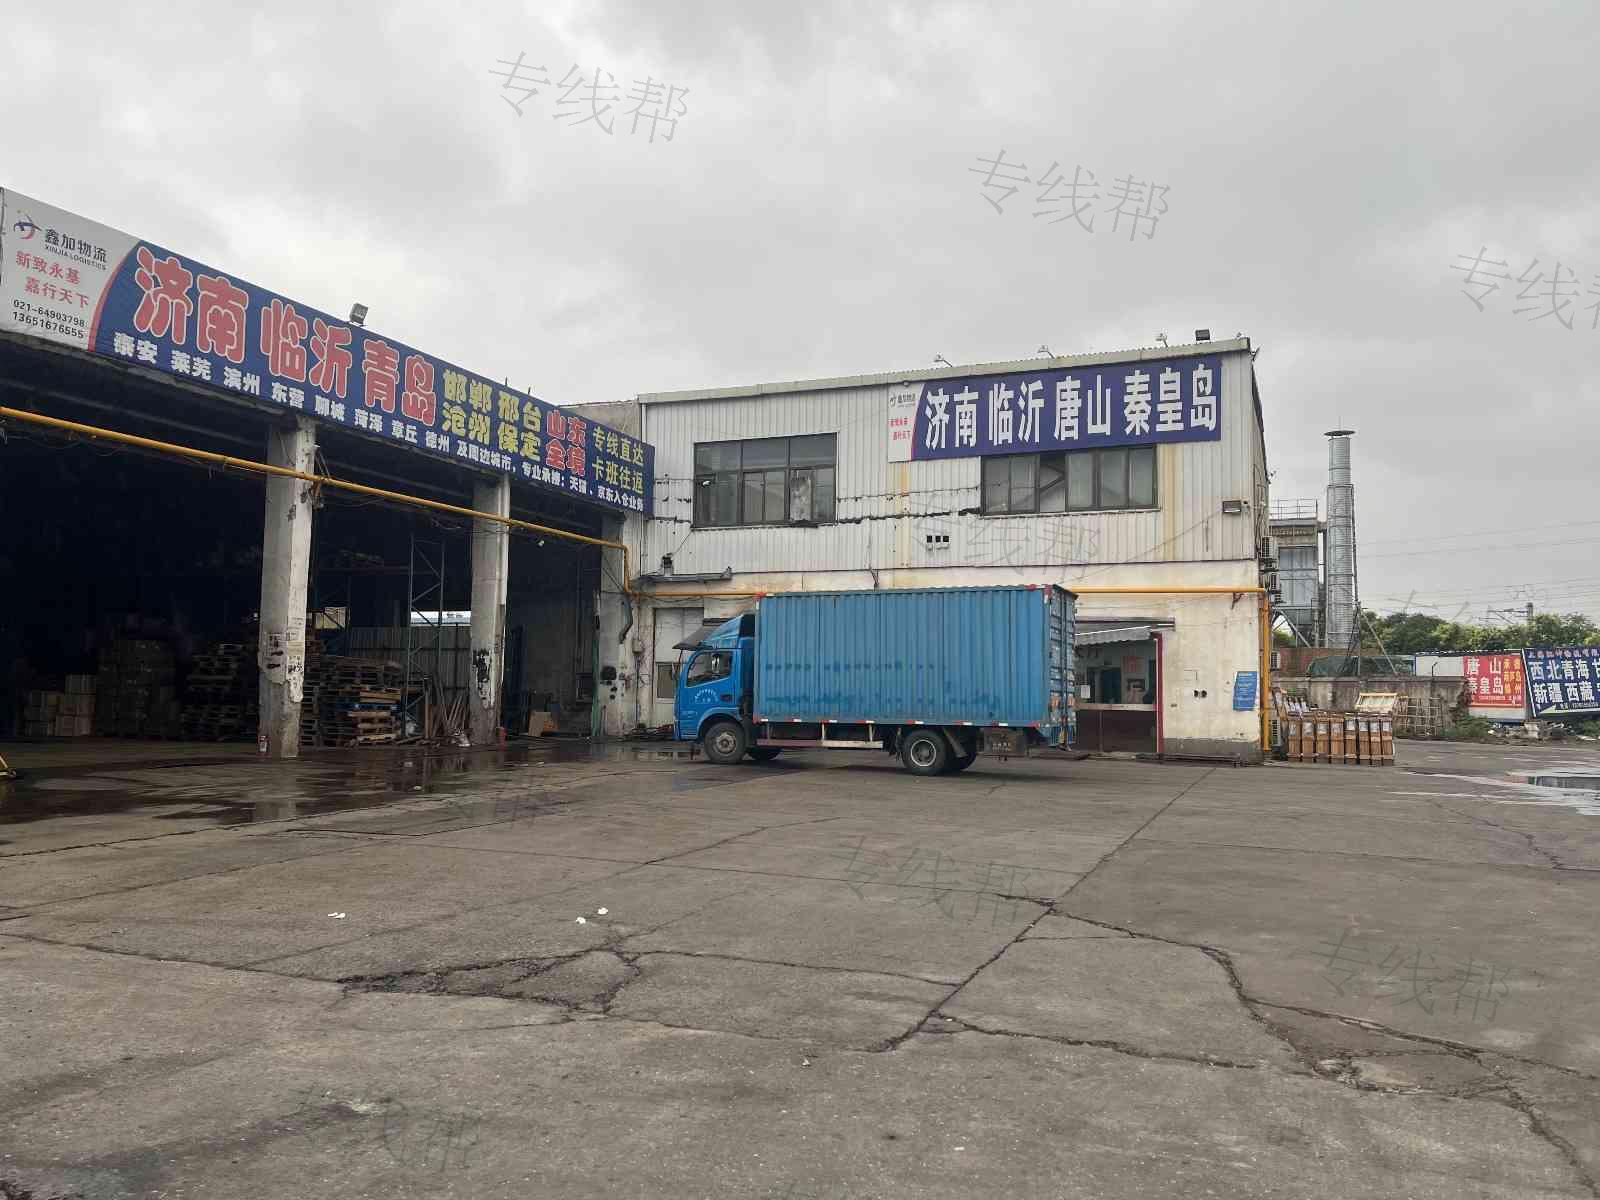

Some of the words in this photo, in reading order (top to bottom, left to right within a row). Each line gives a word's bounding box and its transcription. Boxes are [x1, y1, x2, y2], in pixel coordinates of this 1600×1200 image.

[44, 228, 107, 263] 鑫加物流
[44, 244, 69, 257] XINJIA
[71, 253, 107, 271] LOGISTICS
[15, 250, 81, 285] 新致永基
[25, 276, 90, 309] 嘉行天下
[12, 311, 85, 339] 13651676555
[134, 246, 249, 364] 济南
[260, 298, 352, 398] 临沂
[362, 338, 437, 427] 青岛
[171, 350, 212, 381] 莱芜
[223, 366, 261, 396] 滨州
[271, 382, 305, 409] 东营
[354, 408, 383, 433] 菏泽
[391, 420, 418, 444] 章丘
[425, 430, 450, 453] 德州
[443, 368, 493, 413] 邯郸
[498, 389, 542, 433] 邢台
[925, 385, 979, 450] 济南
[988, 379, 1046, 446] 临沂
[1053, 374, 1112, 442] 唐山
[1123, 363, 1217, 436] 秦皇岛
[441, 401, 491, 446] 沧州
[498, 422, 542, 461] 保定
[546, 409, 587, 448] 山东
[592, 426, 645, 467] 专线直达
[545, 438, 586, 477] 全境
[592, 455, 645, 495] 卡班往返
[1467, 657, 1502, 676] 唐山
[1467, 677, 1504, 695] 秦皇岛
